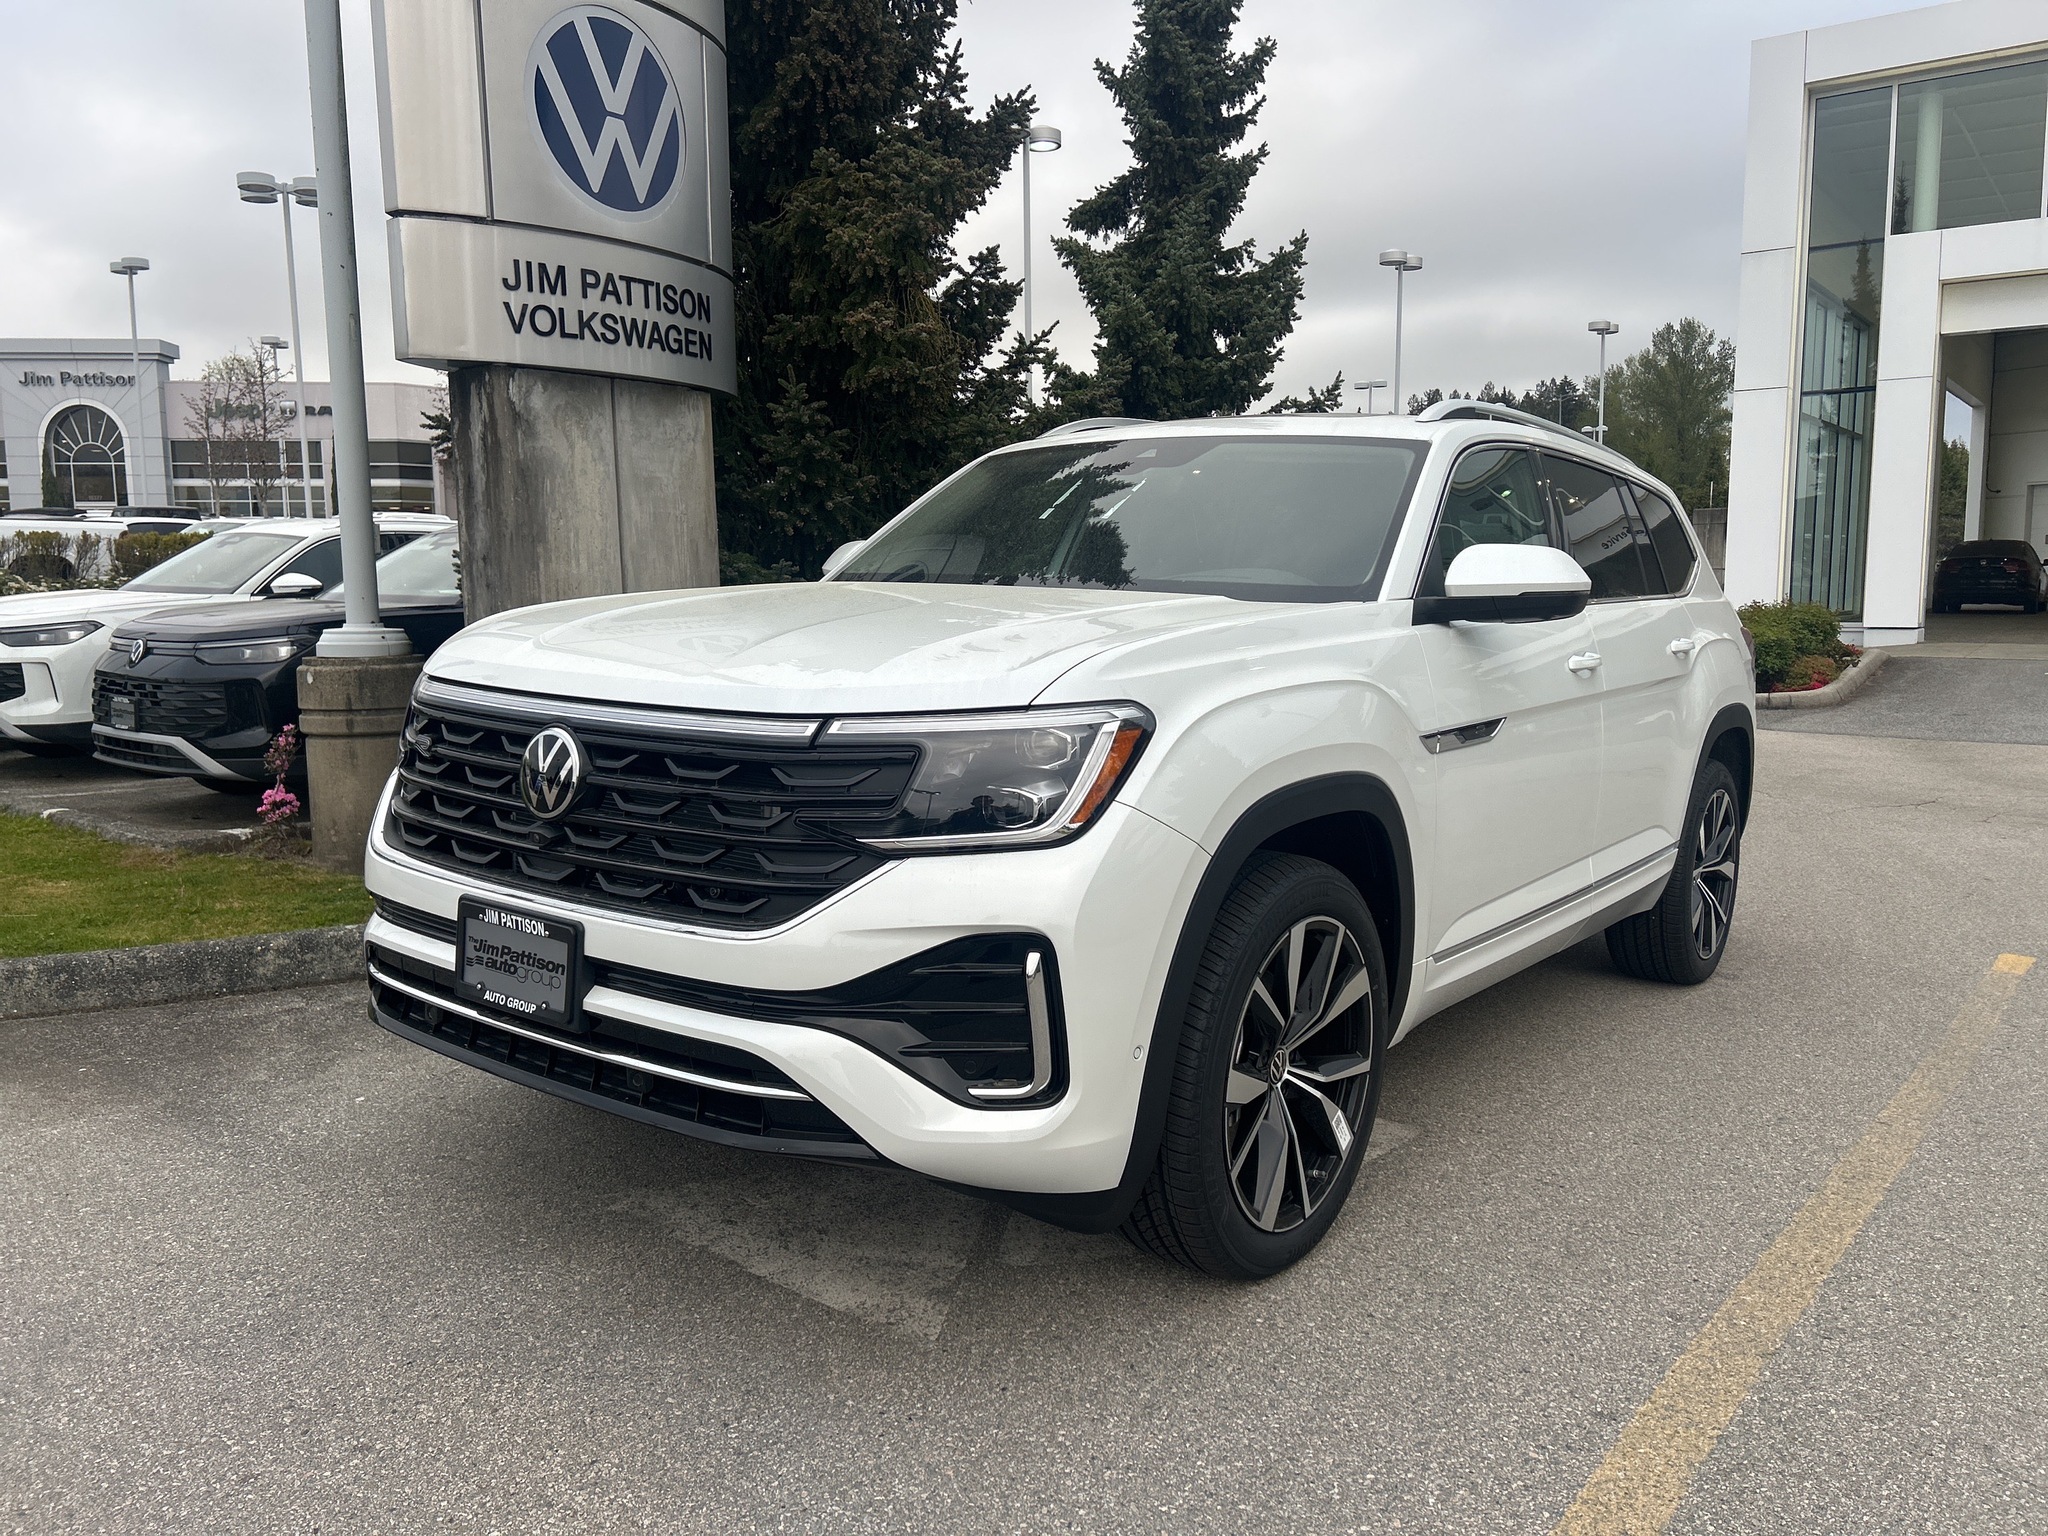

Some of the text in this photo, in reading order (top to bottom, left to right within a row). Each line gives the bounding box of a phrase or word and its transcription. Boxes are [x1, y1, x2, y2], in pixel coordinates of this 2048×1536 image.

[502, 258, 711, 323] JIM PATTISON
[502, 301, 713, 361] VOLKSWAGEN
[19, 371, 54, 386] Jim
[305, 405, 333, 417] RA
[484, 909, 545, 937] JIM PATTISON
[468, 935, 479, 945] The
[483, 990, 537, 1014] AUTO GROUP
